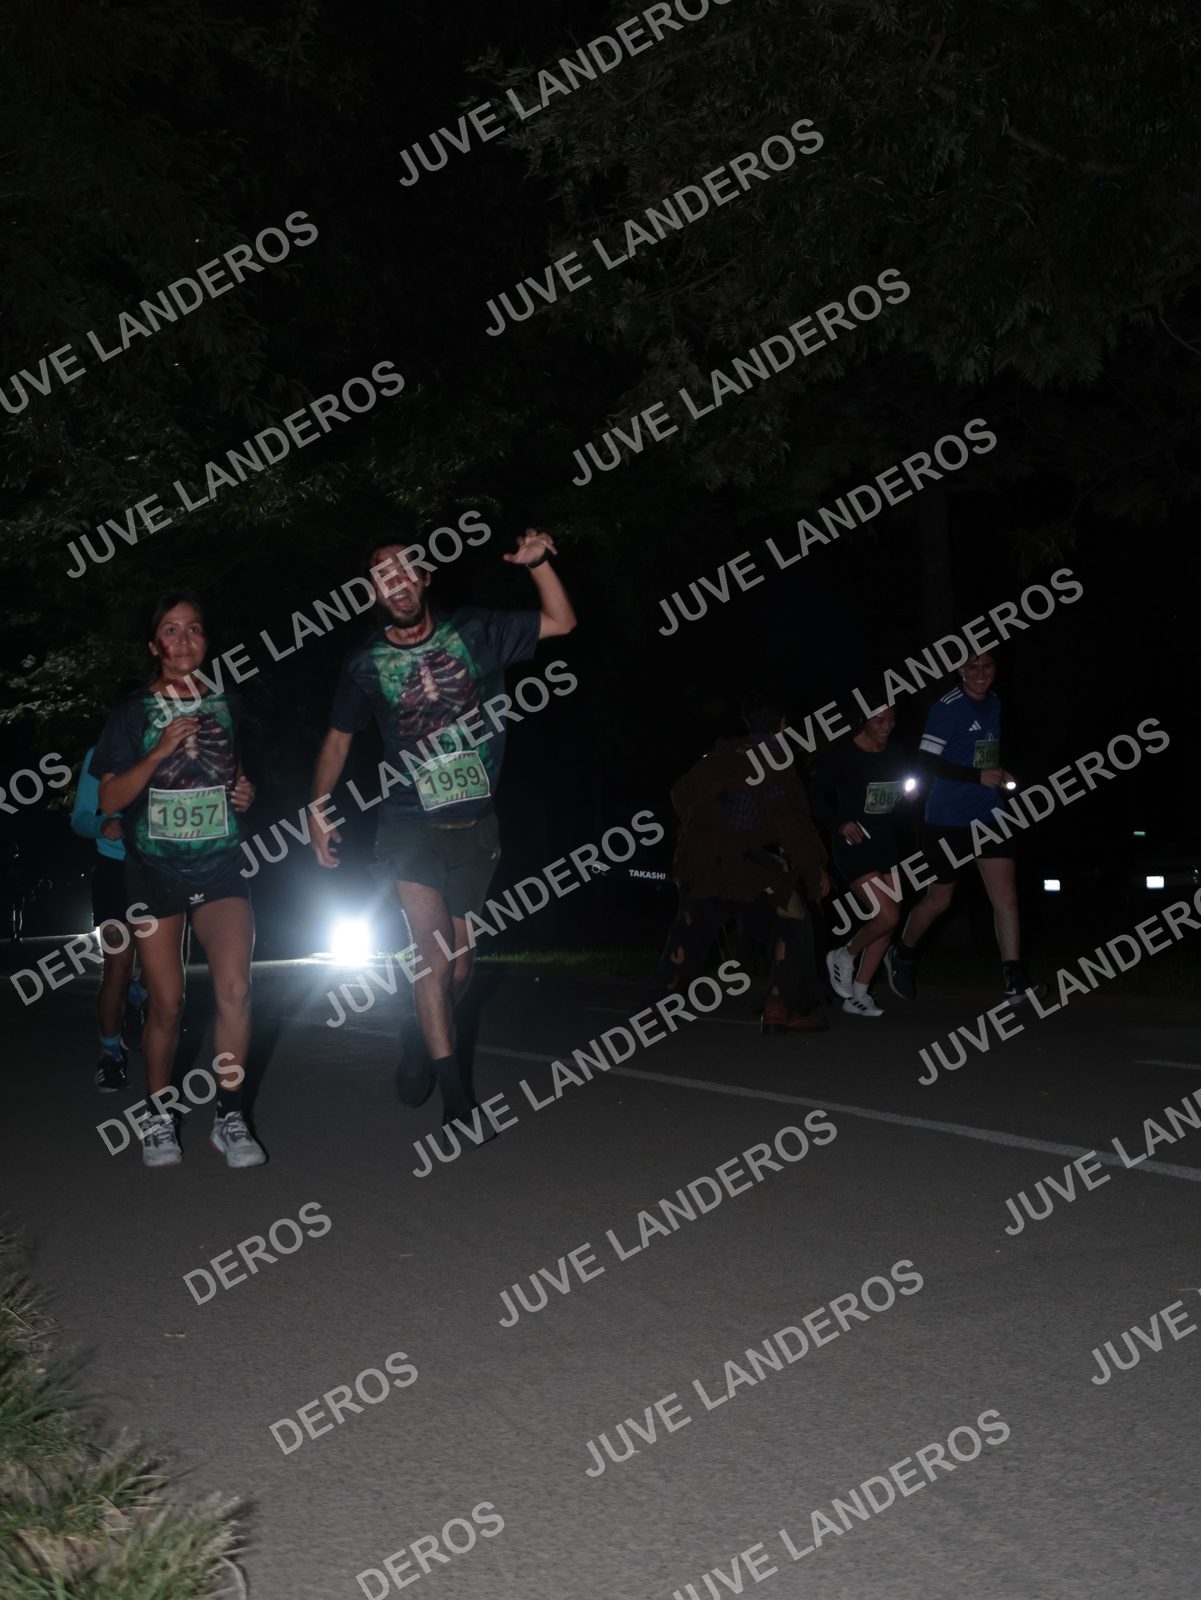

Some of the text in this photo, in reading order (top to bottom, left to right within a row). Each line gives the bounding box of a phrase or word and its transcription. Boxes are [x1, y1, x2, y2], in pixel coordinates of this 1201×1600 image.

[424, 766, 480, 794] 1959
[158, 804, 219, 828] 1957
[628, 869, 666, 880] TAKASHI
